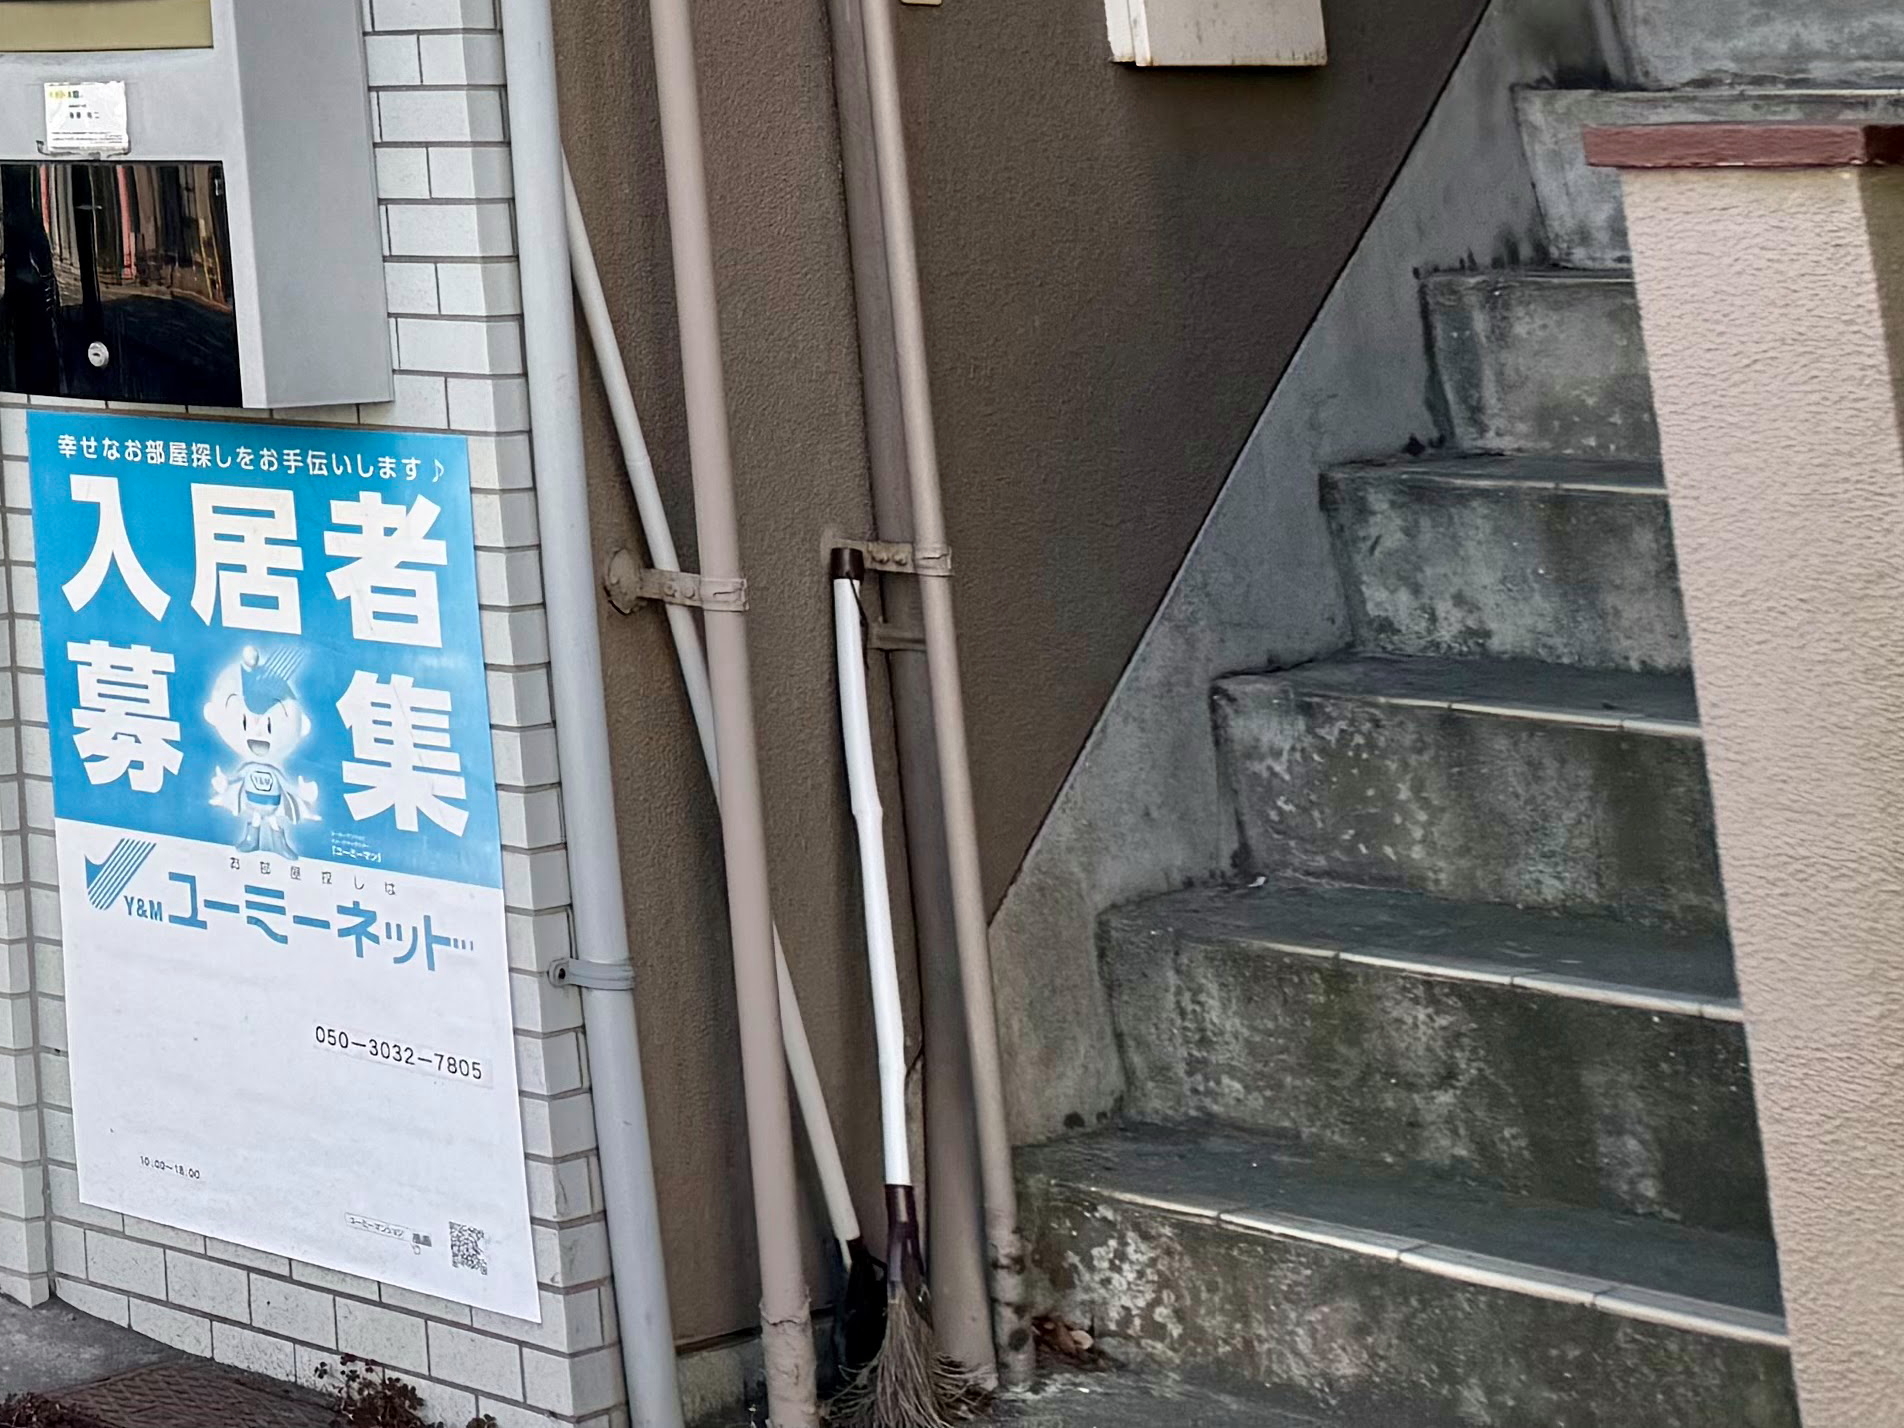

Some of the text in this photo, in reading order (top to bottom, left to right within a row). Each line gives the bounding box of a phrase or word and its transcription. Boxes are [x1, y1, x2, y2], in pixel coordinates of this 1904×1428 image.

[61, 474, 448, 649] 入居者
[229, 856, 396, 896] お部屋探しは
[124, 871, 474, 972] Y&M ユーミーネット
[315, 1024, 483, 1081] 050-3032-7805
